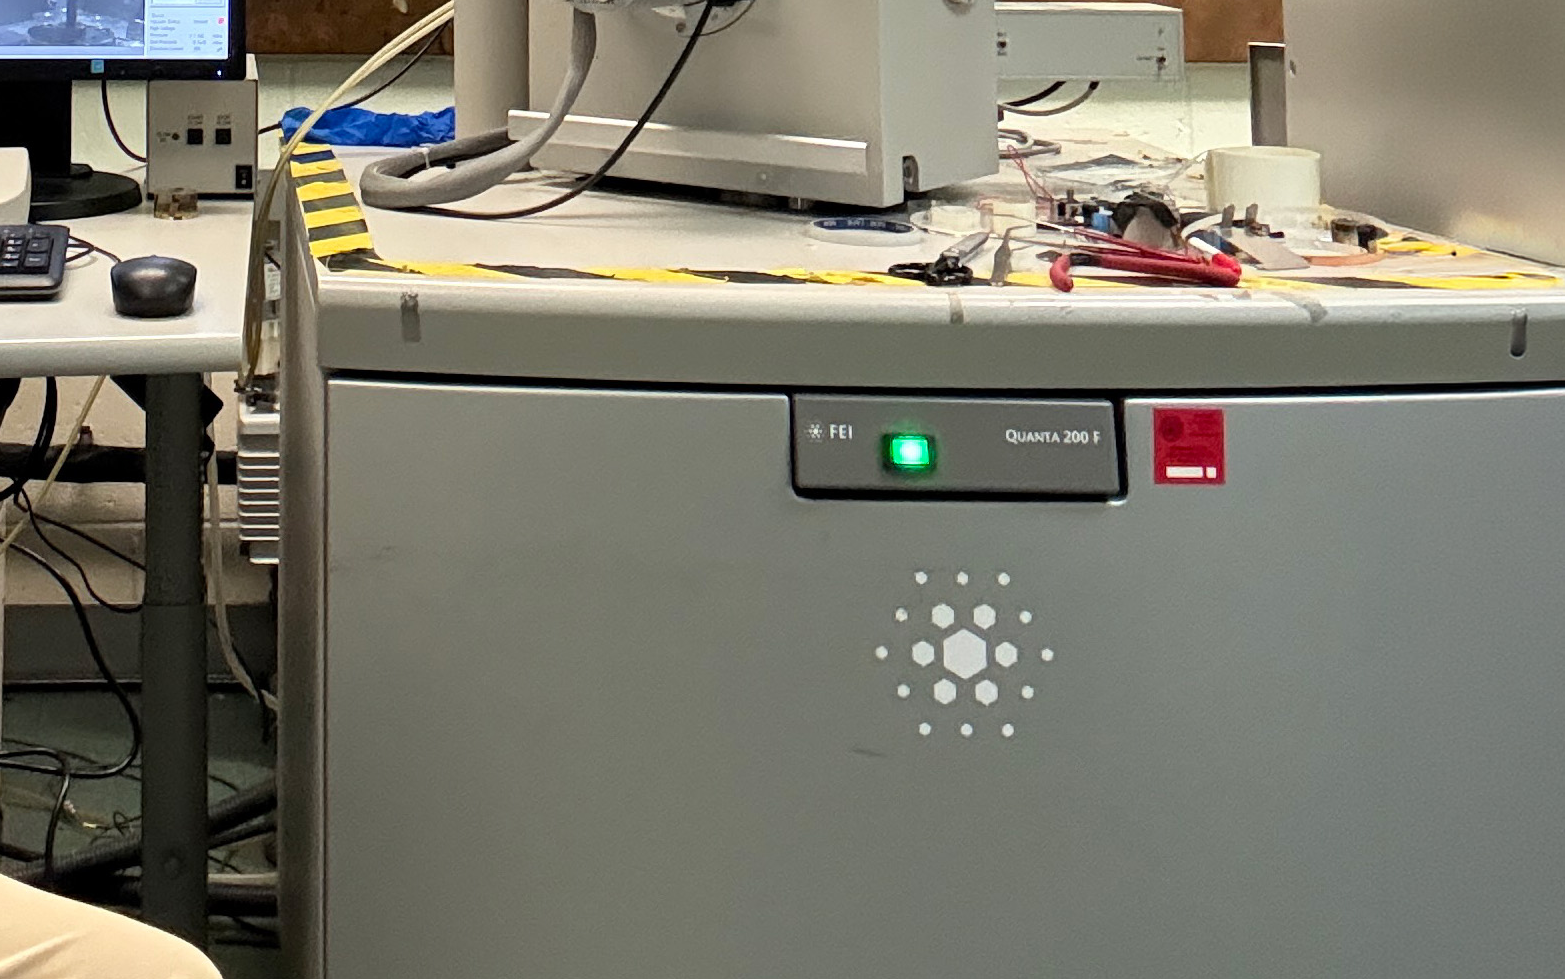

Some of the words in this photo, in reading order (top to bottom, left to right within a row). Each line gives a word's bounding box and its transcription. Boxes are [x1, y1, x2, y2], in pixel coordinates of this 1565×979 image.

[829, 423, 853, 440] FEI
[1005, 428, 1060, 445] QUANTA
[1063, 430, 1089, 445] 200
[1092, 430, 1101, 445] F
